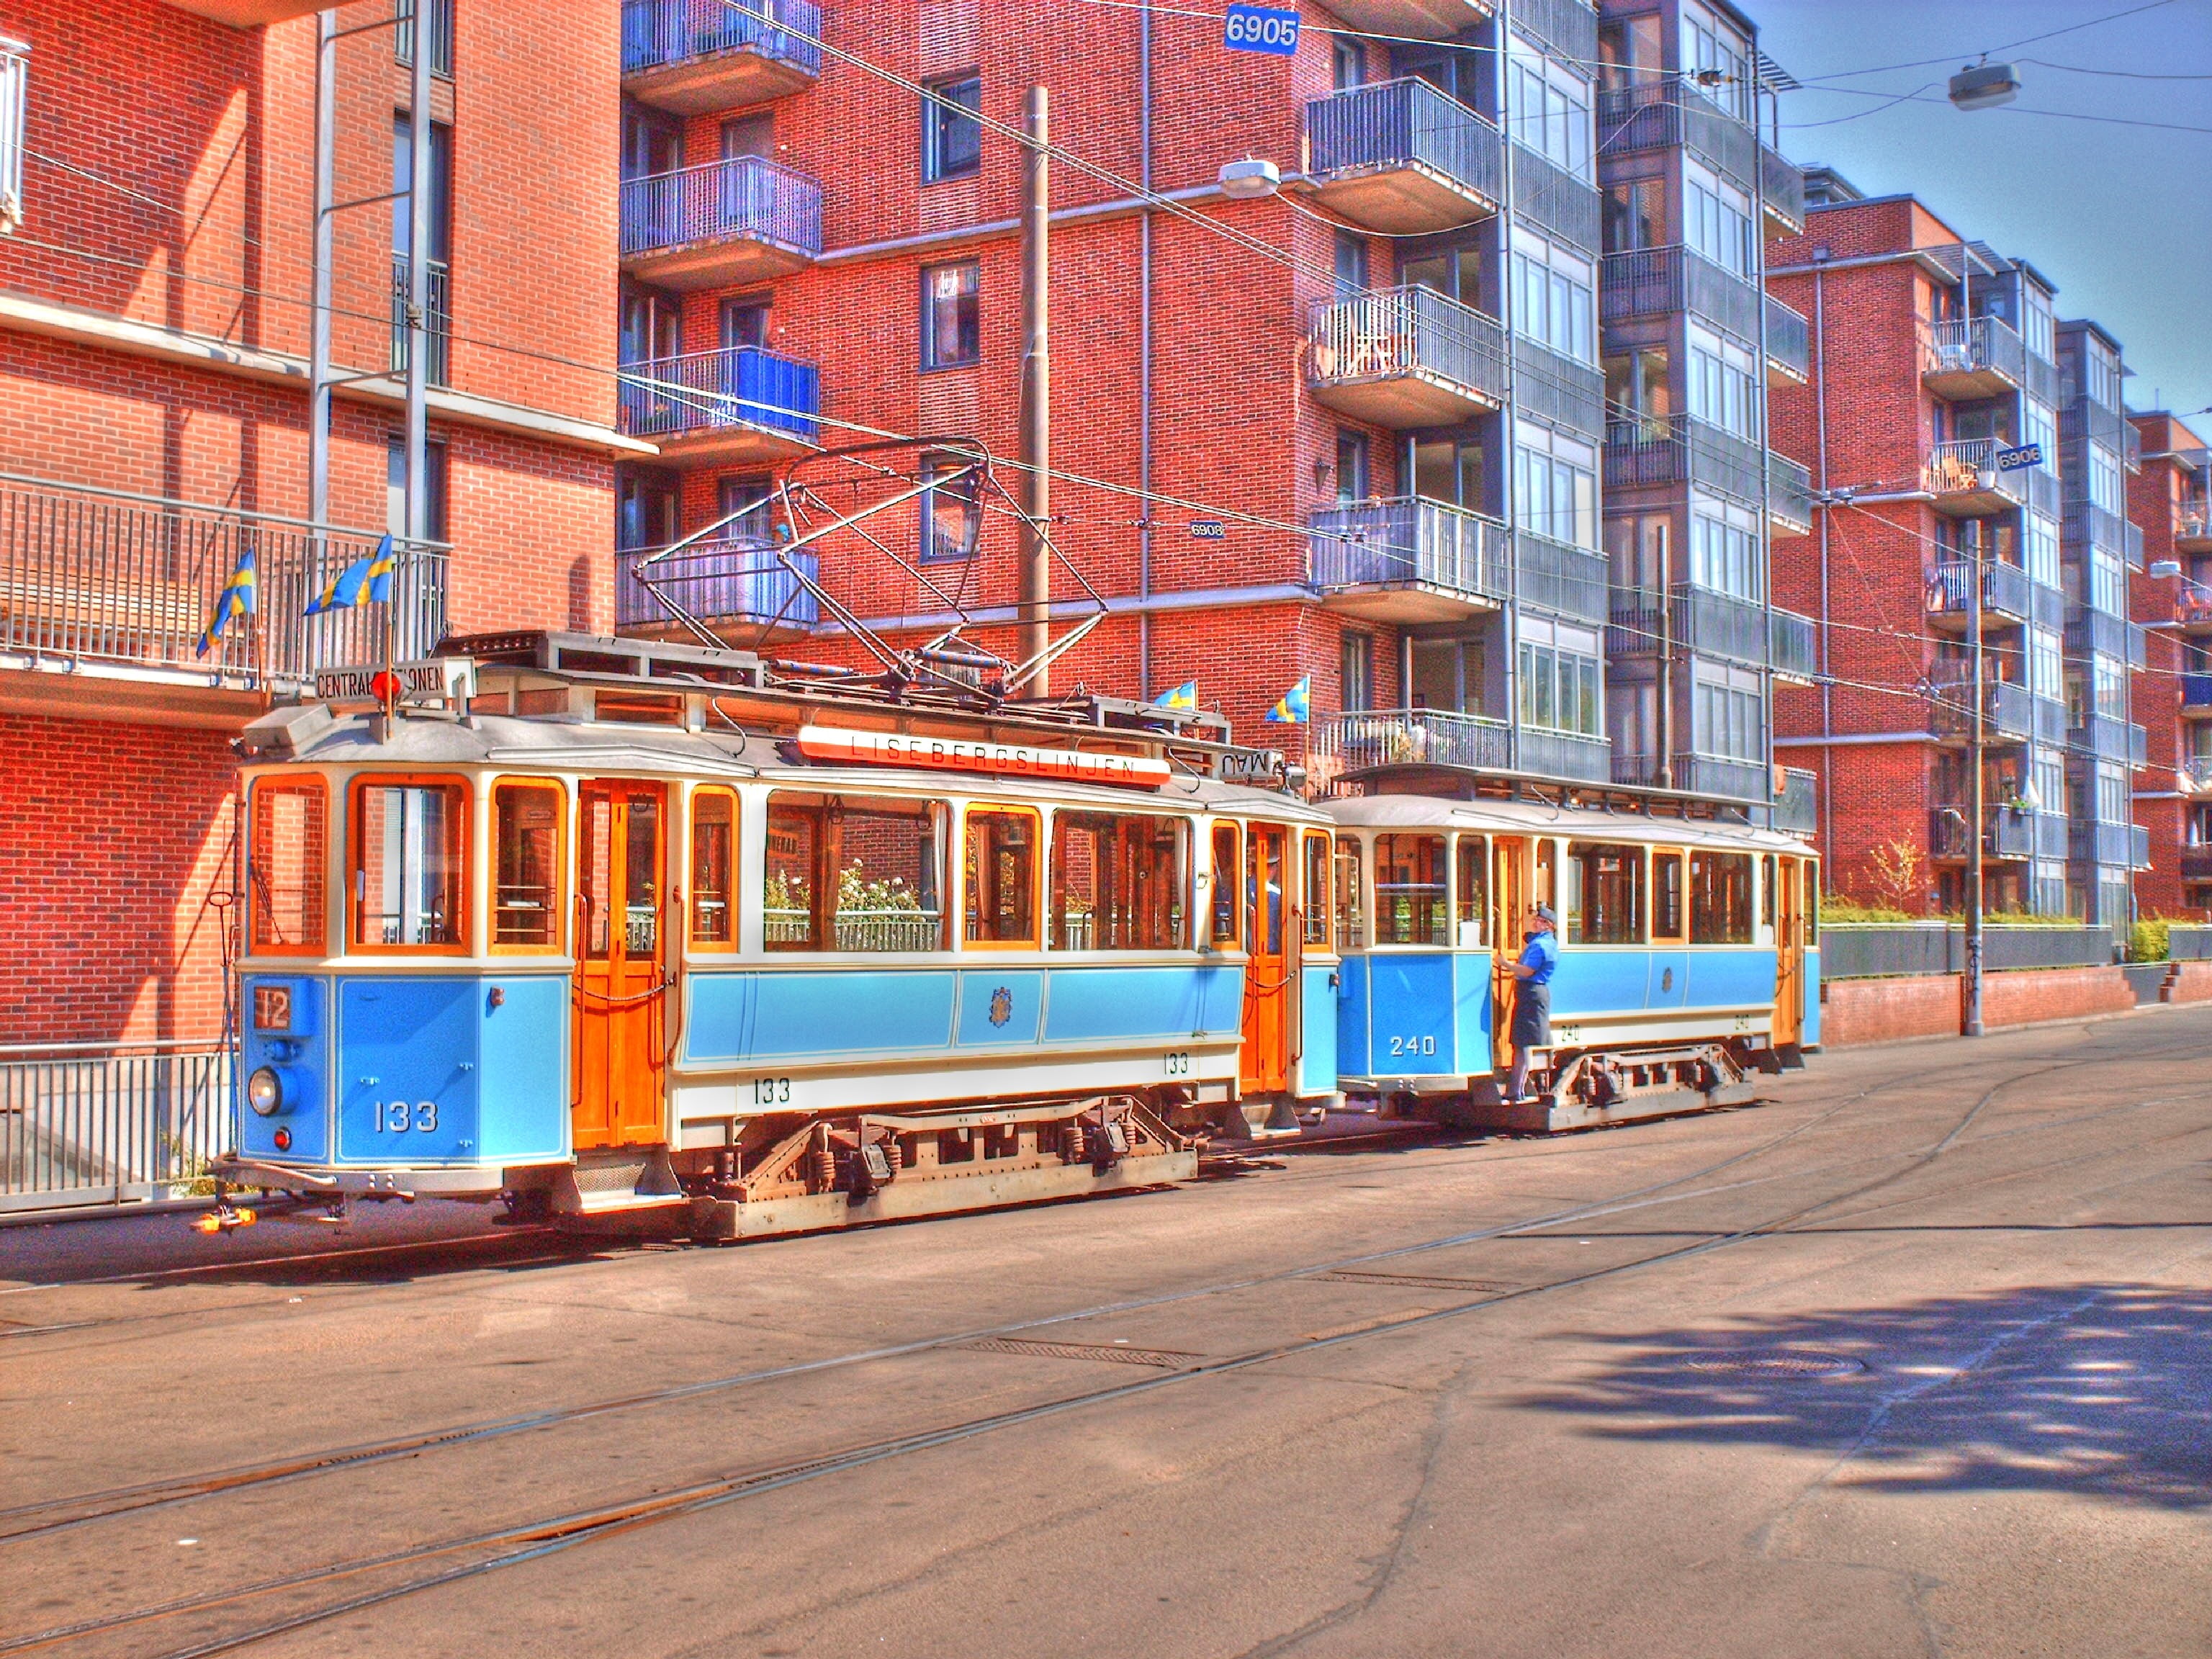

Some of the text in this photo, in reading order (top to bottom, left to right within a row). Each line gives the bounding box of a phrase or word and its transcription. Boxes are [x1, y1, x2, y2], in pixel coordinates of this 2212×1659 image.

[1227, 14, 1296, 46] 6905
[1999, 447, 2040, 467] 6906
[1192, 525, 1223, 535] 6908
[318, 667, 444, 698] CENTRALONEN
[851, 736, 1134, 778] LISEBERGSLINJEN
[259, 990, 289, 1028] 12
[1390, 1035, 1436, 1056] 240
[1164, 1053, 1188, 1075] 133
[755, 1078, 789, 1104] 133
[374, 1101, 438, 1133] 133
